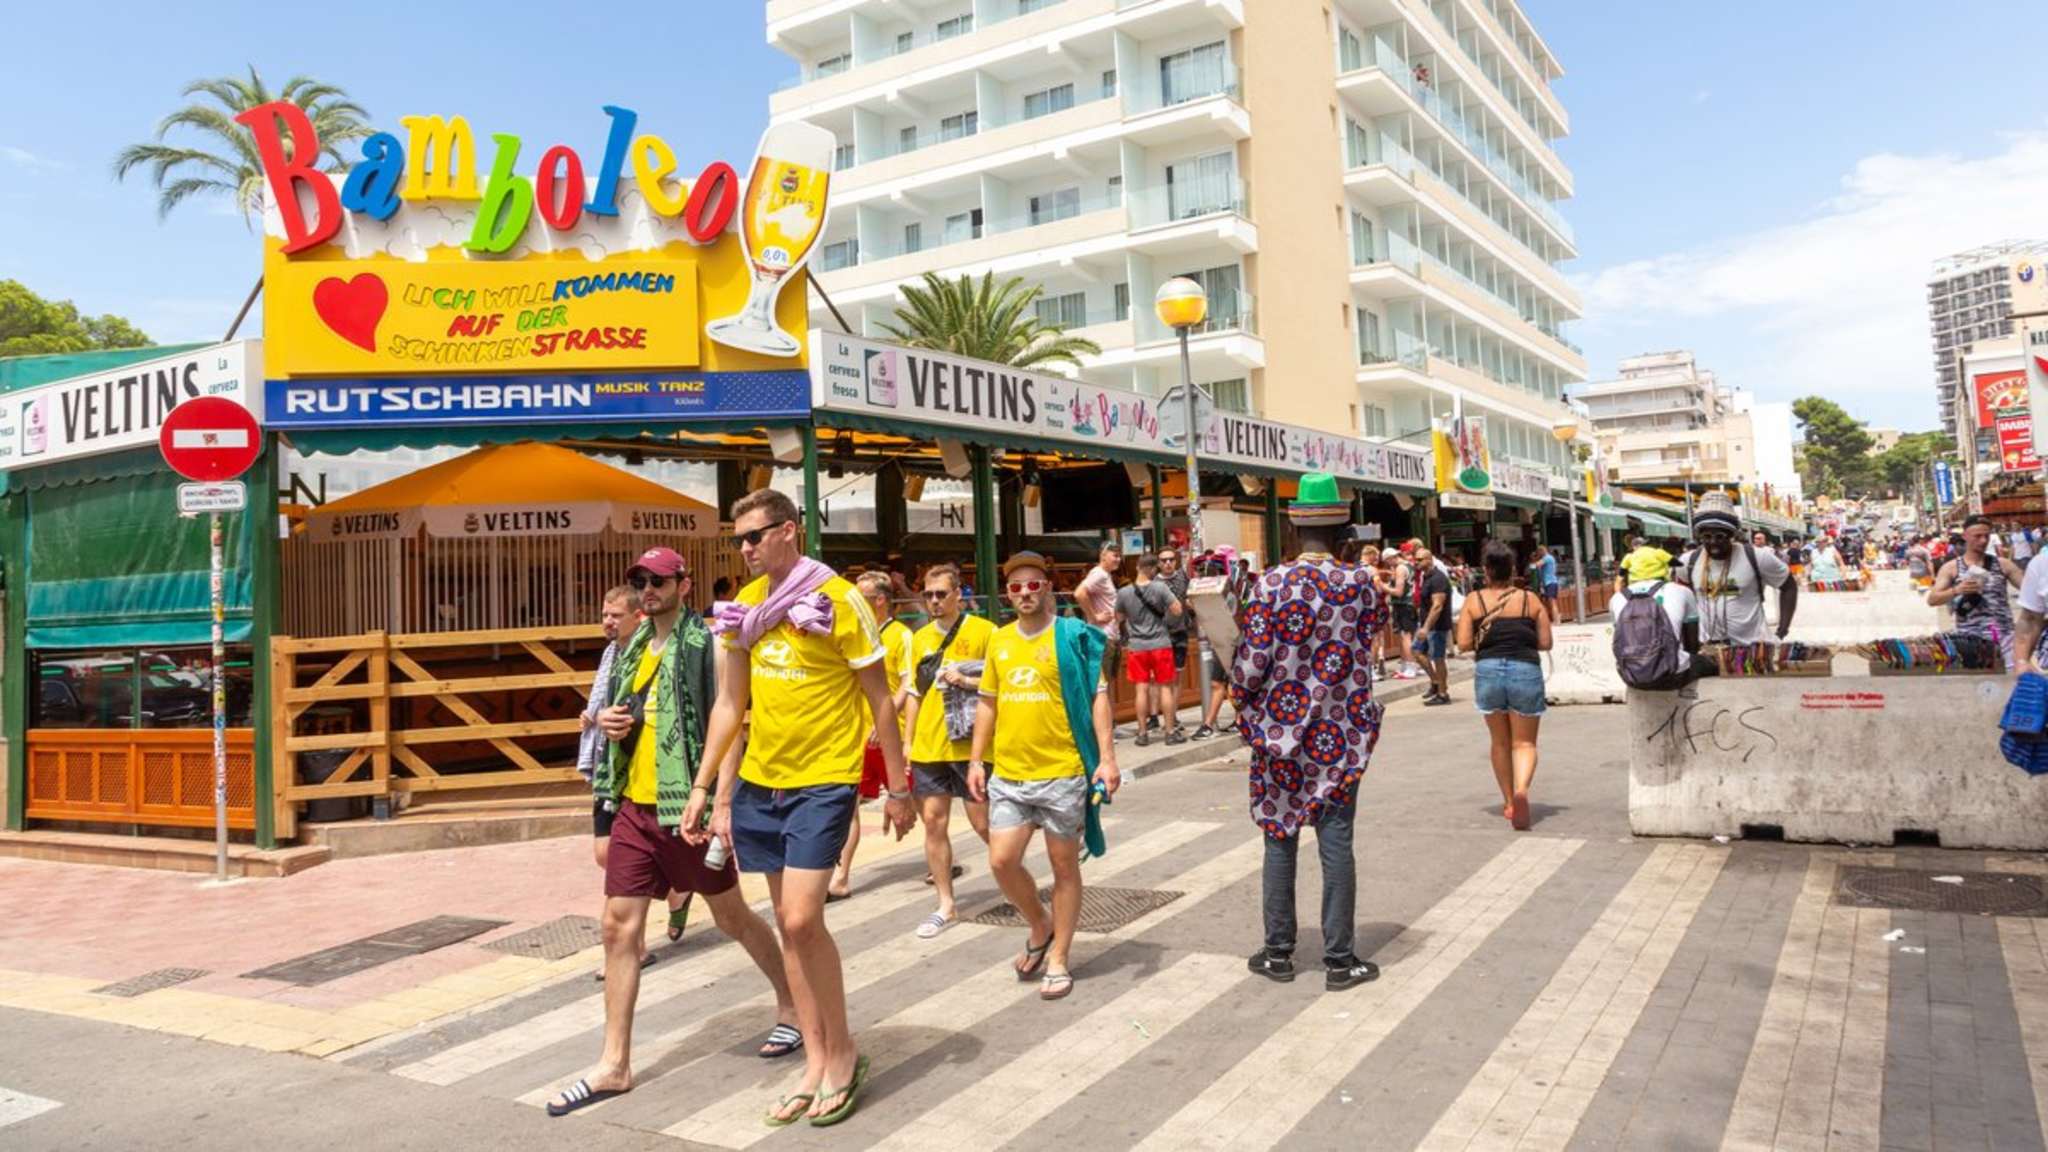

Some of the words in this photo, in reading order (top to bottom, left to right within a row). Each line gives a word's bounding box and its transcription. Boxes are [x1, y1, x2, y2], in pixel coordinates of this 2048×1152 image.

[234, 100, 738, 255] Bamboleo
[448, 314, 504, 338] AUF
[516, 305, 568, 331] DER
[388, 327, 648, 363] SCHINKENSTRASSE
[840, 343, 848, 355] La
[829, 364, 860, 378] cerveza
[61, 361, 200, 443] VELTINS
[287, 384, 590, 413] RUTSCHBAHN
[595, 382, 649, 393] MUSIK
[658, 382, 705, 392] TANZ
[832, 382, 858, 398] fresca
[907, 356, 1036, 423] VELTINS
[1224, 417, 1288, 461] VELTINS
[1387, 450, 1427, 492] VELTINS
[344, 512, 400, 533] VELTINS
[484, 510, 571, 532] VELTINS
[647, 511, 696, 531] VELTINS
